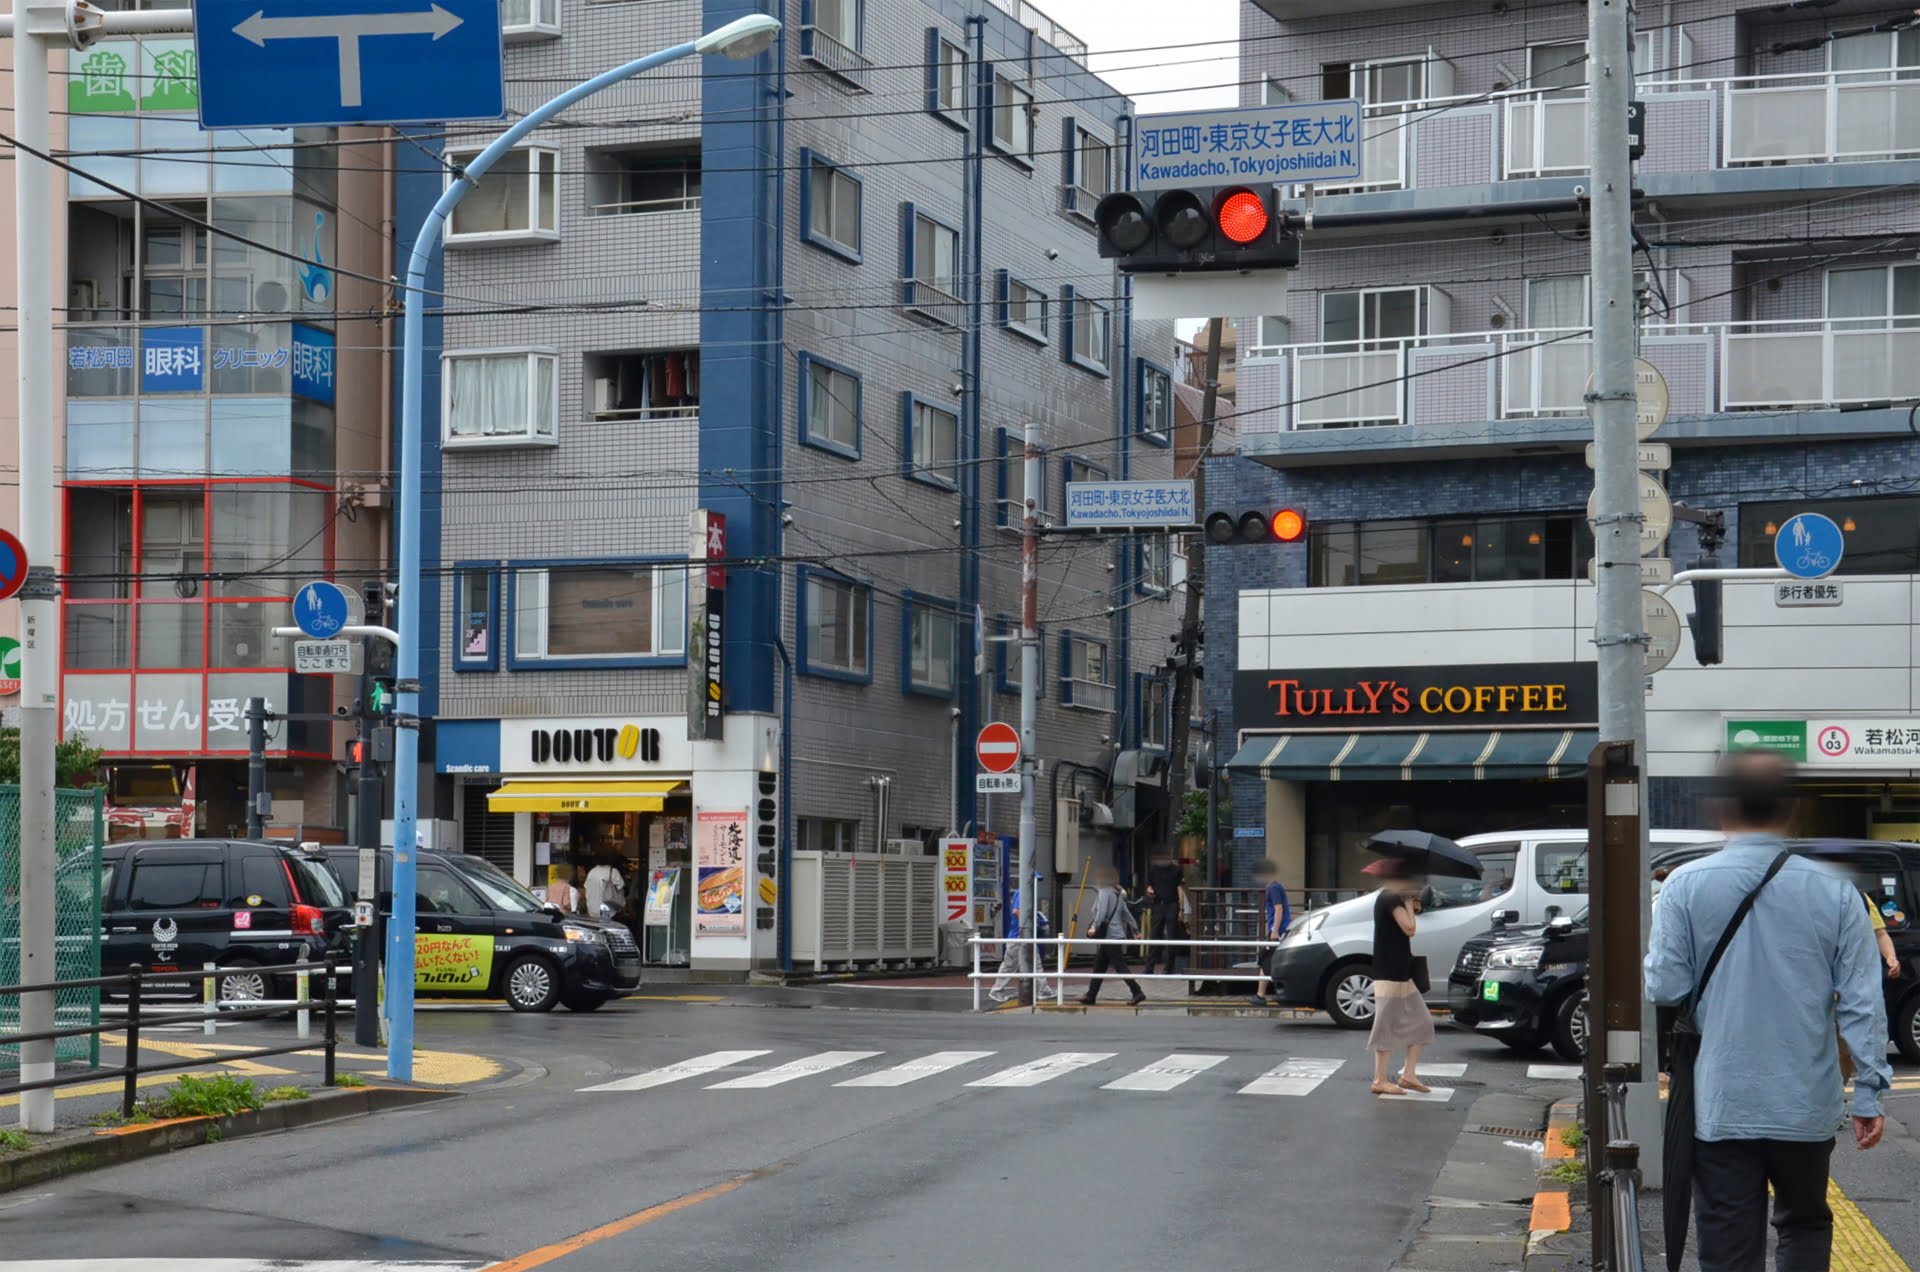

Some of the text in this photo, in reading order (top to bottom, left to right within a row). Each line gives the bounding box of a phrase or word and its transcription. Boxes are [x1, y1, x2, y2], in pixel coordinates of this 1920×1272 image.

[1140, 115, 1355, 158] 河田町・東京女子医大北
[1340, 149, 1356, 166] N.
[69, 346, 289, 376] 若松河田 眼科 クリニック
[293, 341, 333, 388] 眼科
[1071, 489, 1190, 506] 河田町・東京女子医大北
[708, 522, 723, 555] 本
[1779, 584, 1838, 600] 歩行者優先
[299, 658, 348, 669] ここまで
[708, 613, 721, 718] DOUTOR
[1419, 684, 1567, 713] COFFEE
[532, 723, 660, 762] DOUTOR
[1831, 731, 1837, 740] E
[1826, 740, 1842, 751] 03
[758, 773, 778, 930] DOUTOR
[945, 855, 967, 867] 100
[945, 881, 967, 892] 100
[415, 938, 472, 955] 20円なんて
